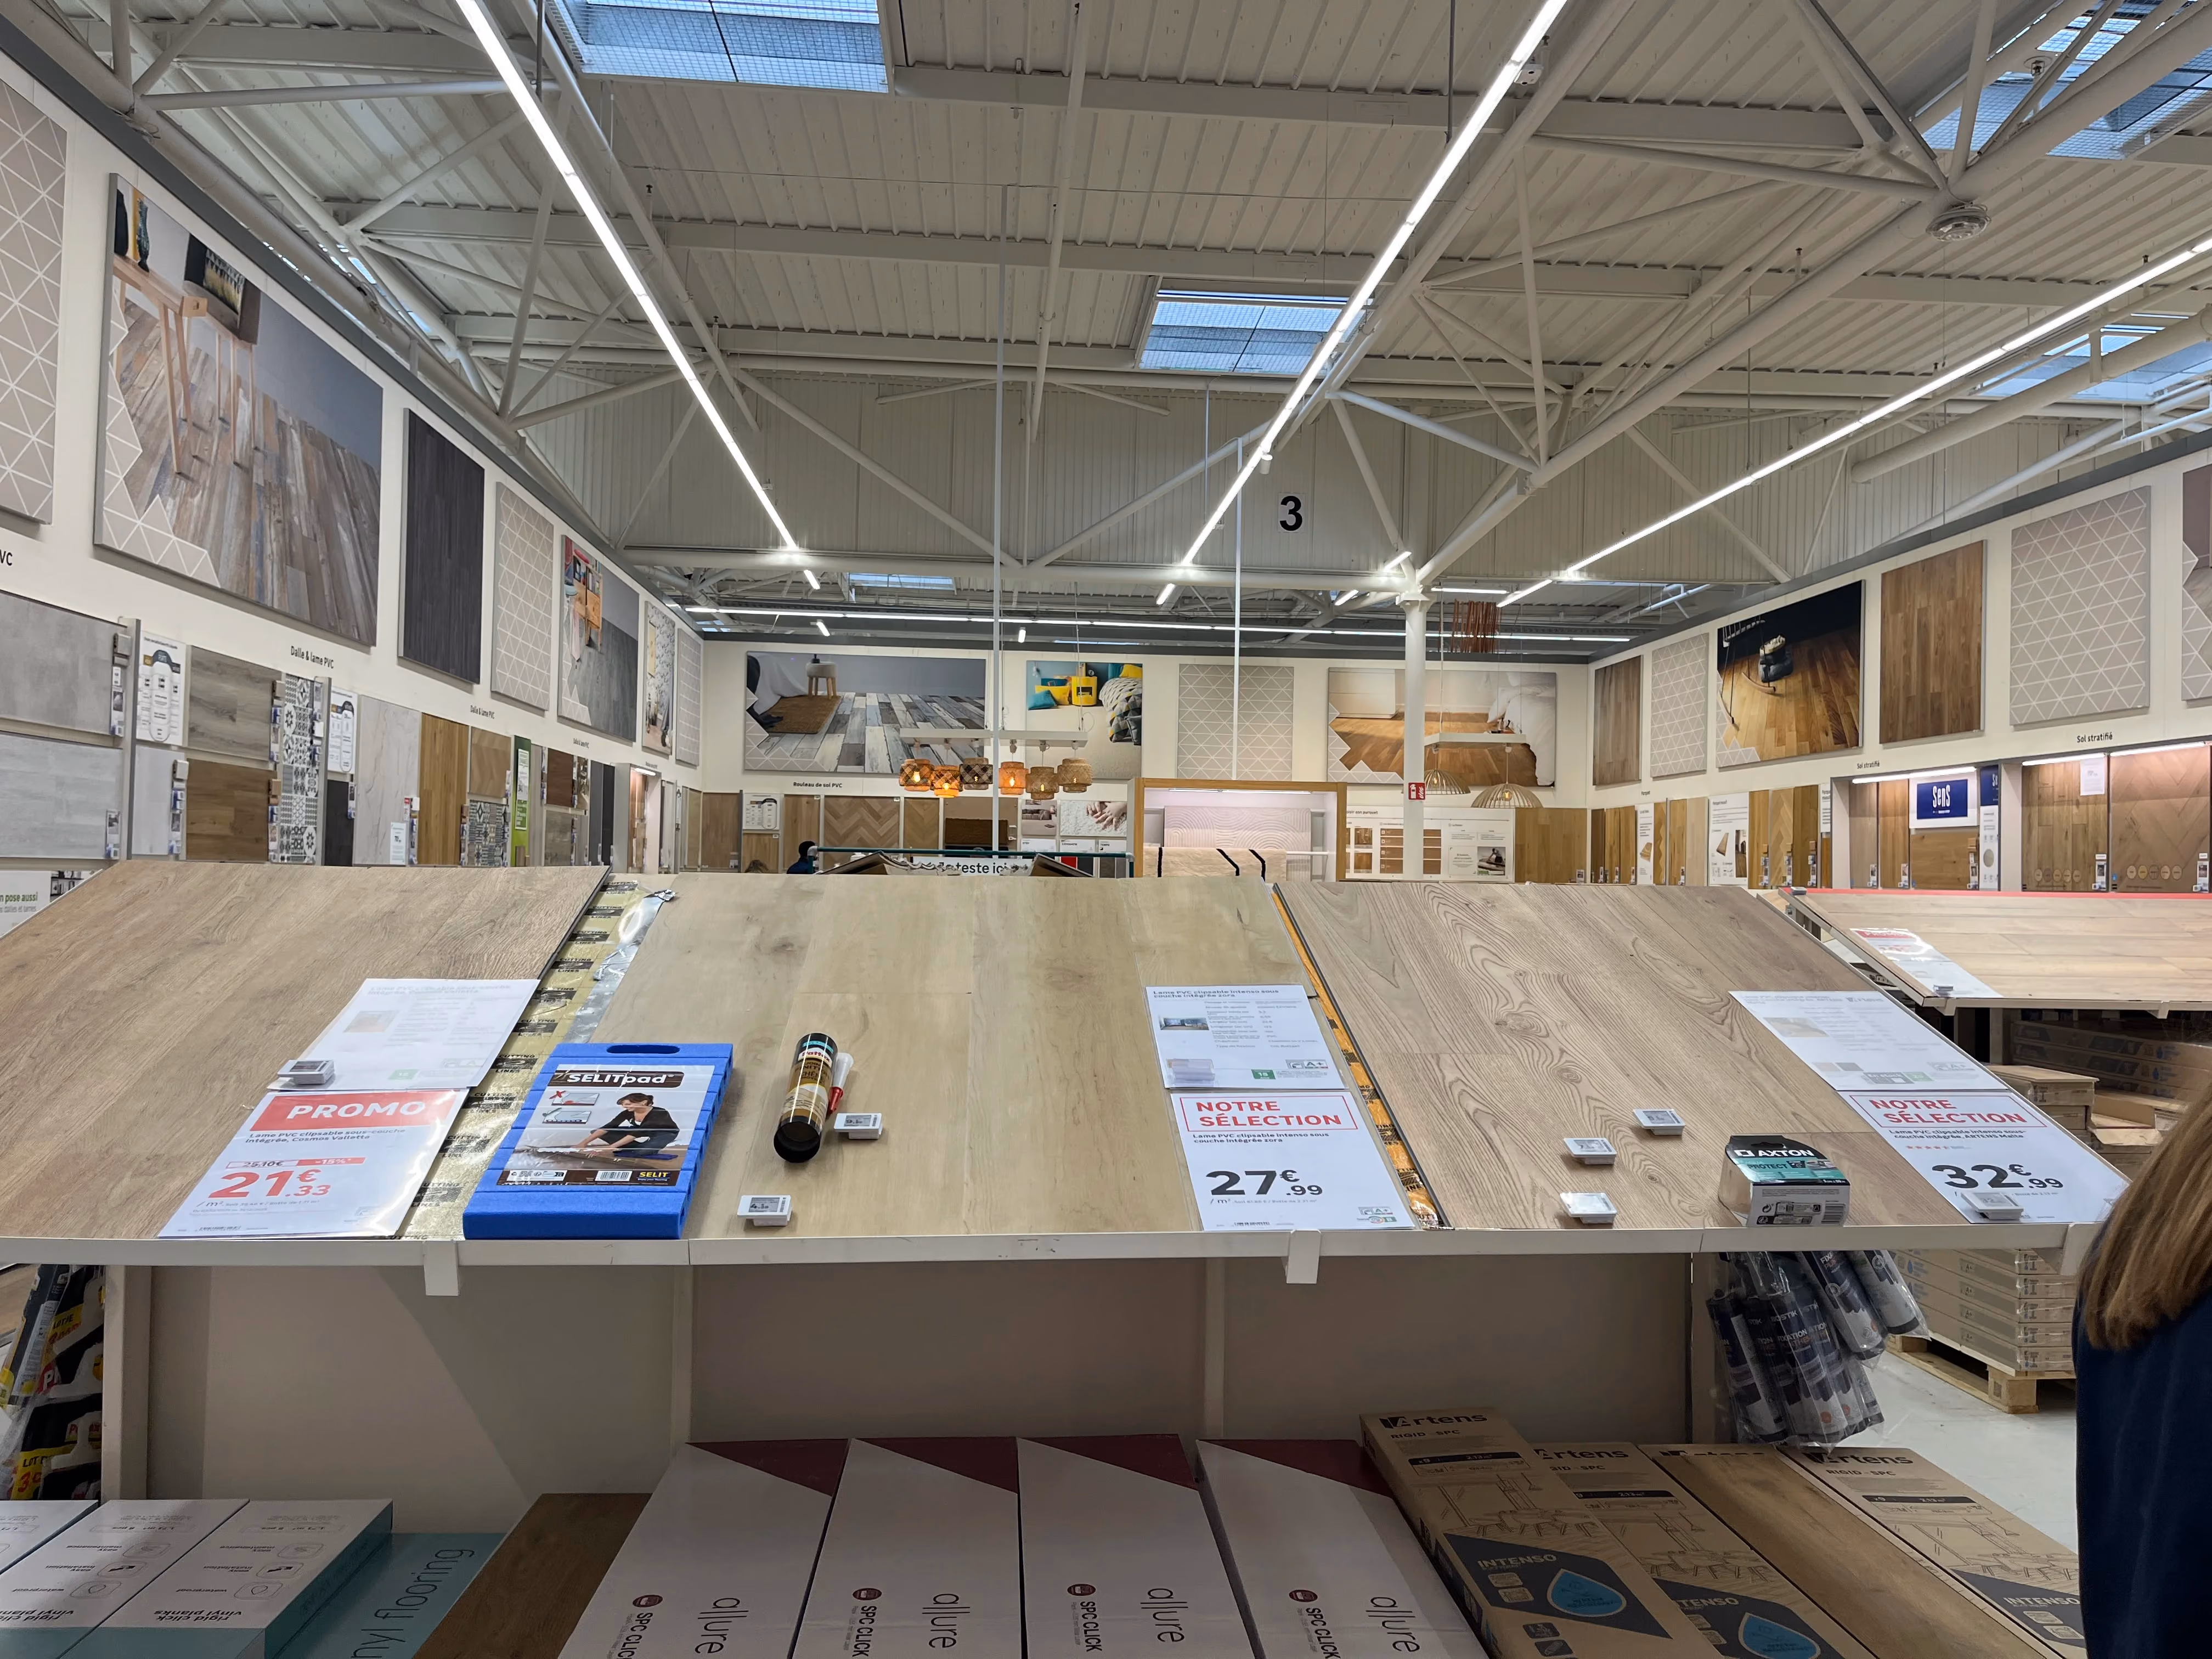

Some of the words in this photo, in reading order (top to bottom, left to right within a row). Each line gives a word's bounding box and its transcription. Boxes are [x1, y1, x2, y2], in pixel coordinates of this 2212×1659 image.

[1280, 496, 1302, 531] 3
[0, 549, 13, 566] VC
[291, 646, 304, 659] Dalle
[306, 651, 309, 661] &
[311, 652, 323, 665] lame
[324, 657, 334, 669] PVC
[2076, 735, 2086, 743] Sol
[2087, 732, 2113, 742] stratifié
[1933, 785, 1950, 808] SenS
[956, 862, 990, 873] teste
[21, 891, 38, 902] aussi
[286, 1101, 426, 1120] PROMO
[1197, 1101, 1280, 1112] NOTRE
[1869, 1099, 1957, 1110] NOTRE
[1199, 1113, 1342, 1127] SÉLECTION
[1883, 1110, 2028, 1124] SÉLECTION
[1379, 1414, 1487, 1429] Artens
[1477, 1554, 1557, 1570] INTENSO
[374, 1549, 475, 1620] flooring
[1080, 1601, 1098, 1620] SPC
[1678, 1597, 1740, 1608] TENSO
[630, 1612, 653, 1632] SPC
[859, 1606, 877, 1624] SPC
[922, 1593, 970, 1648] allure
[1140, 1588, 1189, 1642] allure
[1306, 1607, 1327, 1626] SPC
[1365, 1596, 1420, 1652] allure
[695, 1598, 749, 1654] allure
[351, 1628, 406, 1658] nyl
[617, 1634, 643, 1659] CLIC
[852, 1627, 873, 1657] CLICK
[1083, 1622, 1102, 1652] CLICK
[1315, 1628, 1341, 1659] CLICK
